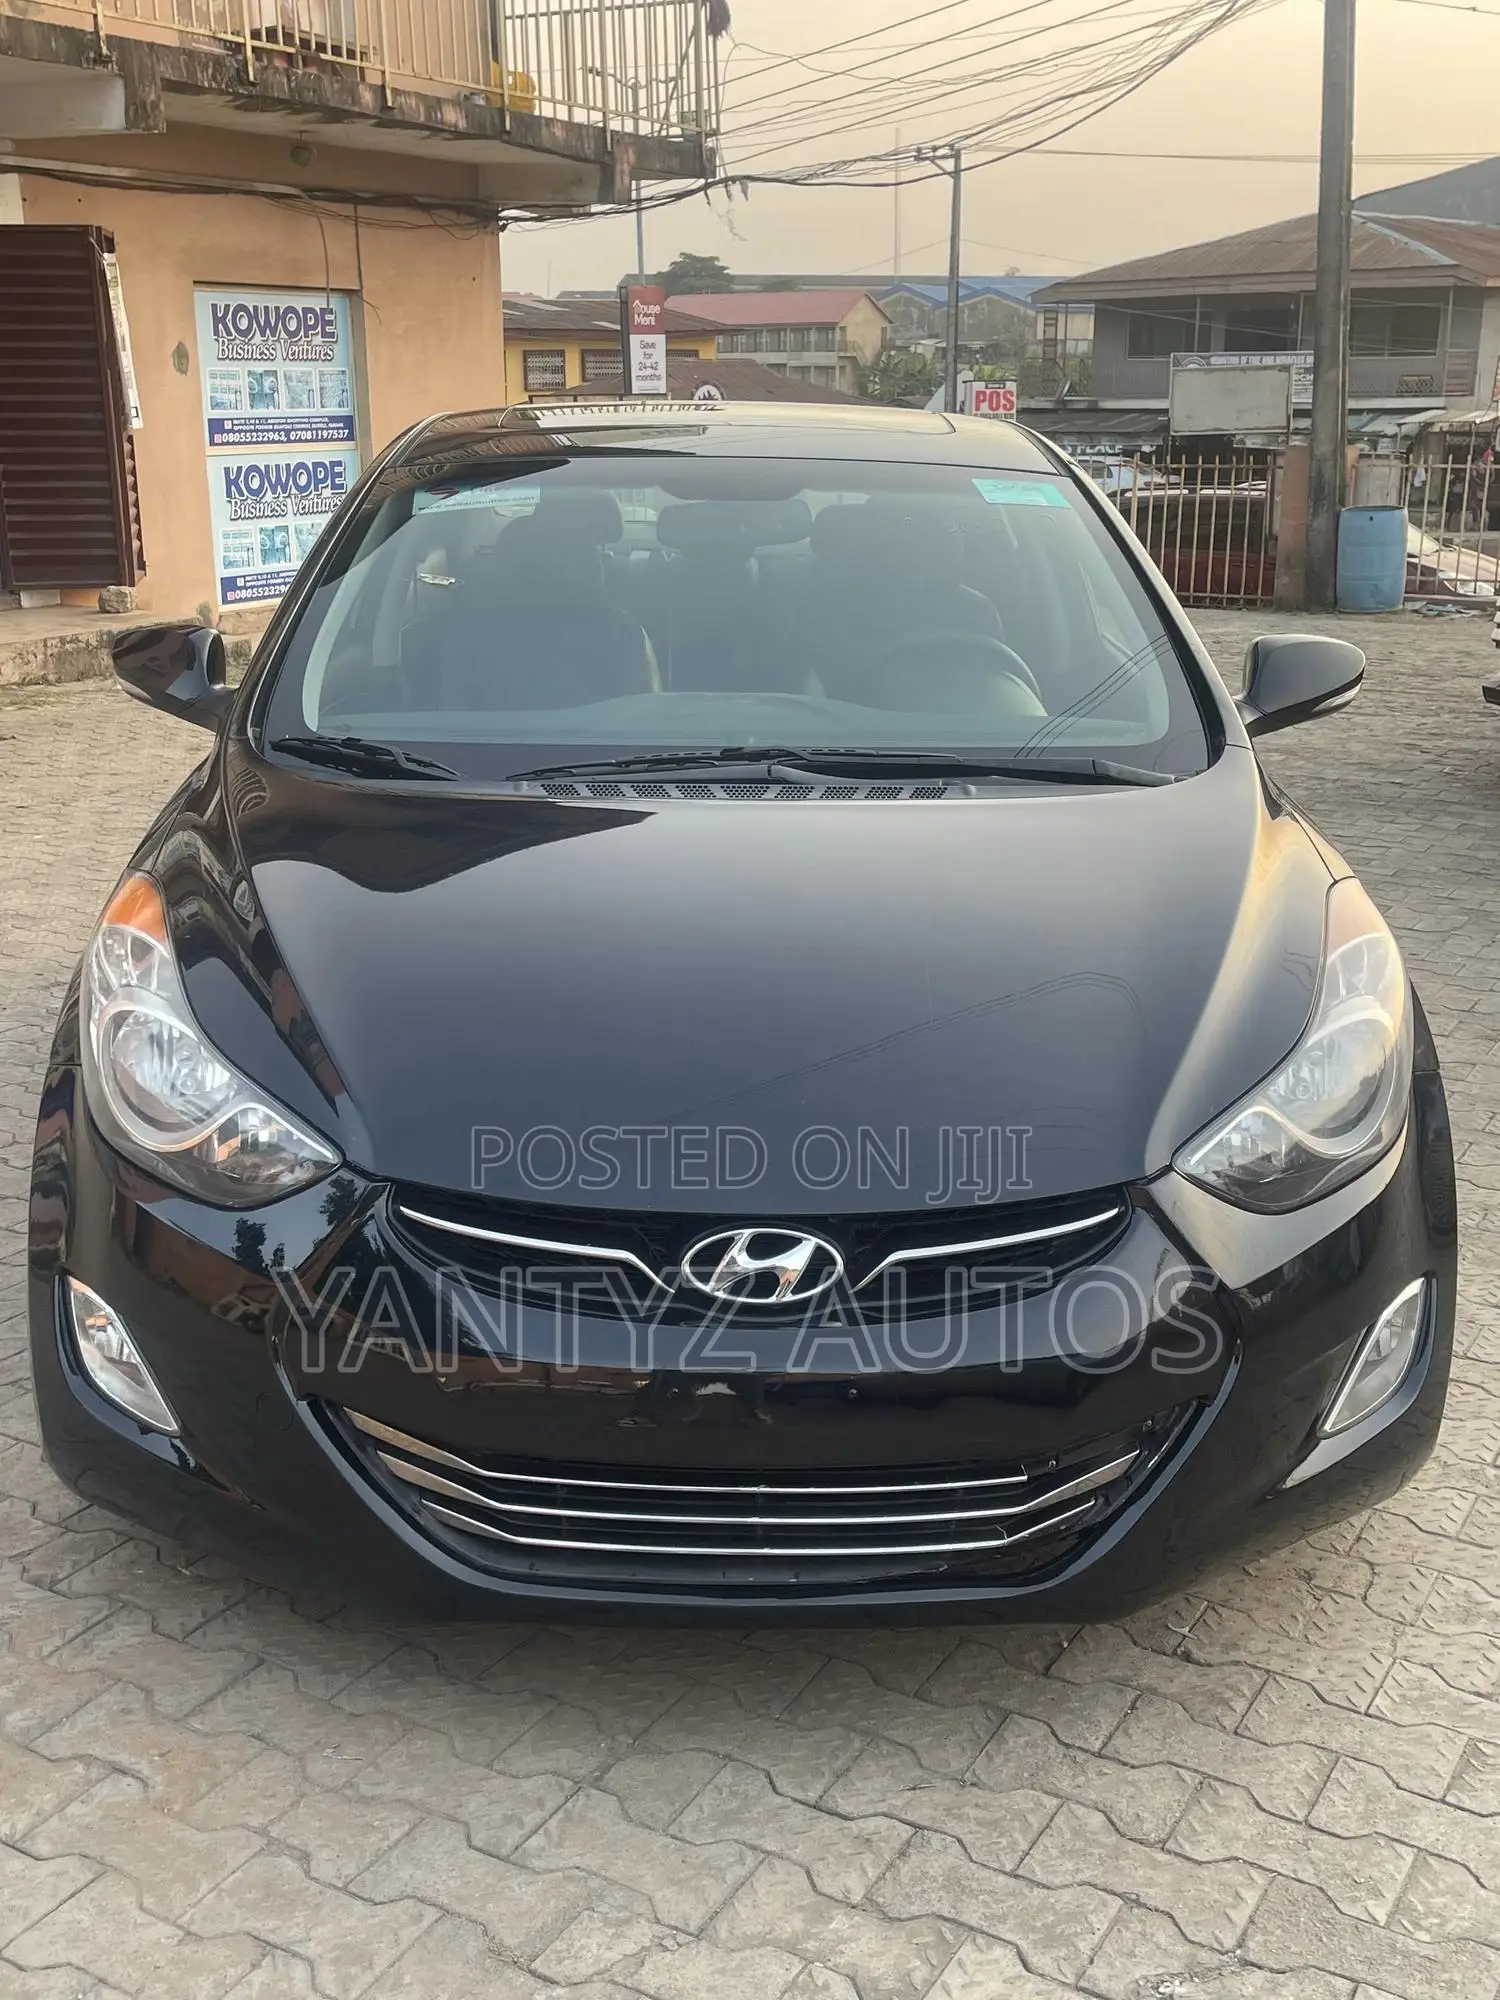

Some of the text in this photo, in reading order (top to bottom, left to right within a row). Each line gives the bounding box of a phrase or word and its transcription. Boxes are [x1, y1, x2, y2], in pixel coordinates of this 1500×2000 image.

[210, 302, 337, 341] KOWOPE
[217, 338, 334, 361] Business Ventures
[639, 340, 656, 350] Save
[643, 352, 653, 360] for
[638, 361, 659, 372] 24-42
[636, 373, 662, 382] months
[975, 390, 1015, 412] POS
[222, 429, 349, 443] 08055232963, 07081197537
[223, 460, 346, 500] KOWOPE
[230, 494, 344, 521] Business Ventures
